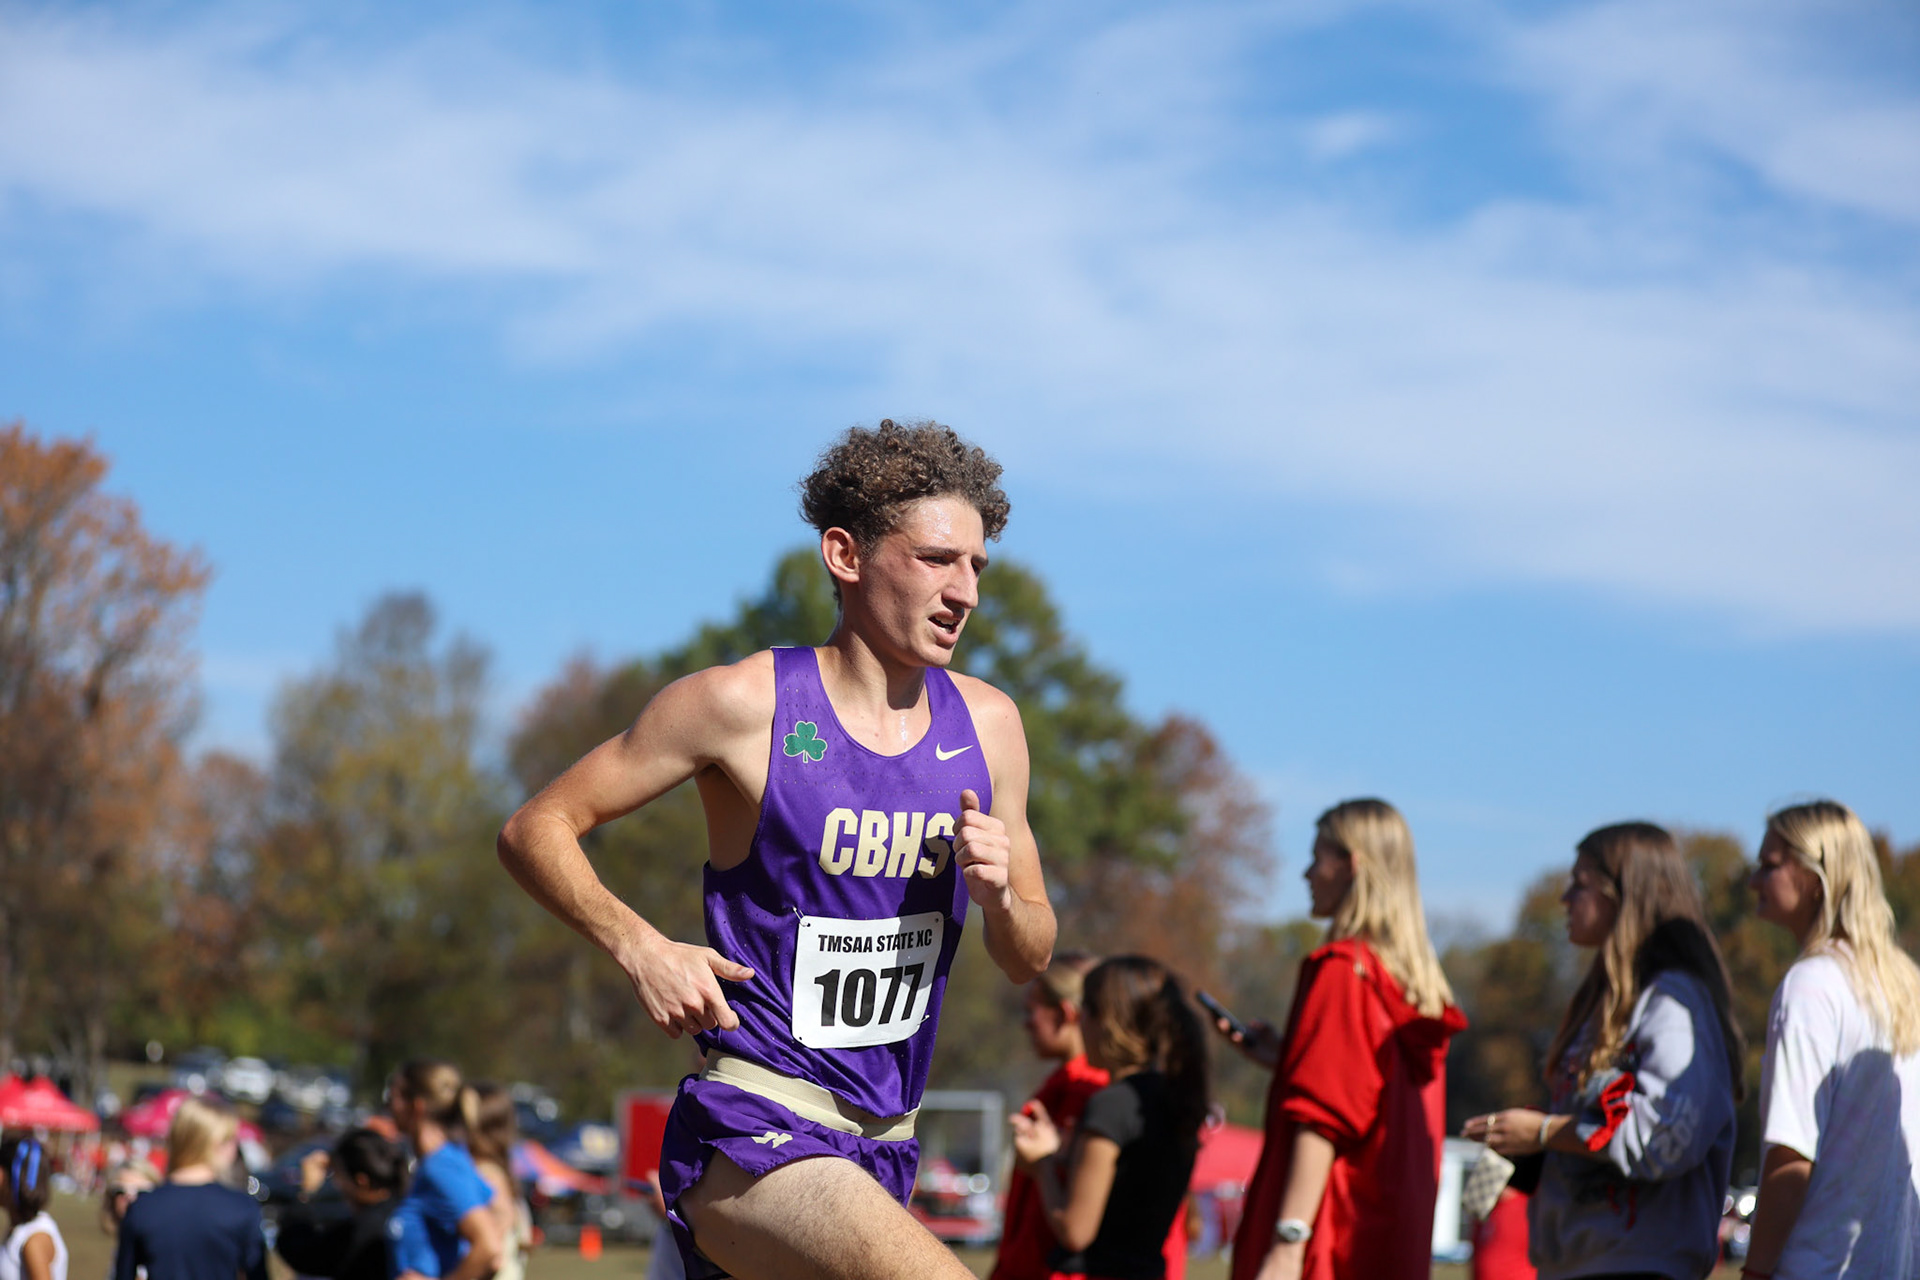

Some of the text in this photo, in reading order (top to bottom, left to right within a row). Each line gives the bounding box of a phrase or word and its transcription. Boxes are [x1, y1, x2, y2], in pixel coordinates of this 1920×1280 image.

[818, 807, 955, 879] CBHS
[818, 928, 933, 953] TMSAA STATE XC
[814, 962, 925, 1028] 1077
